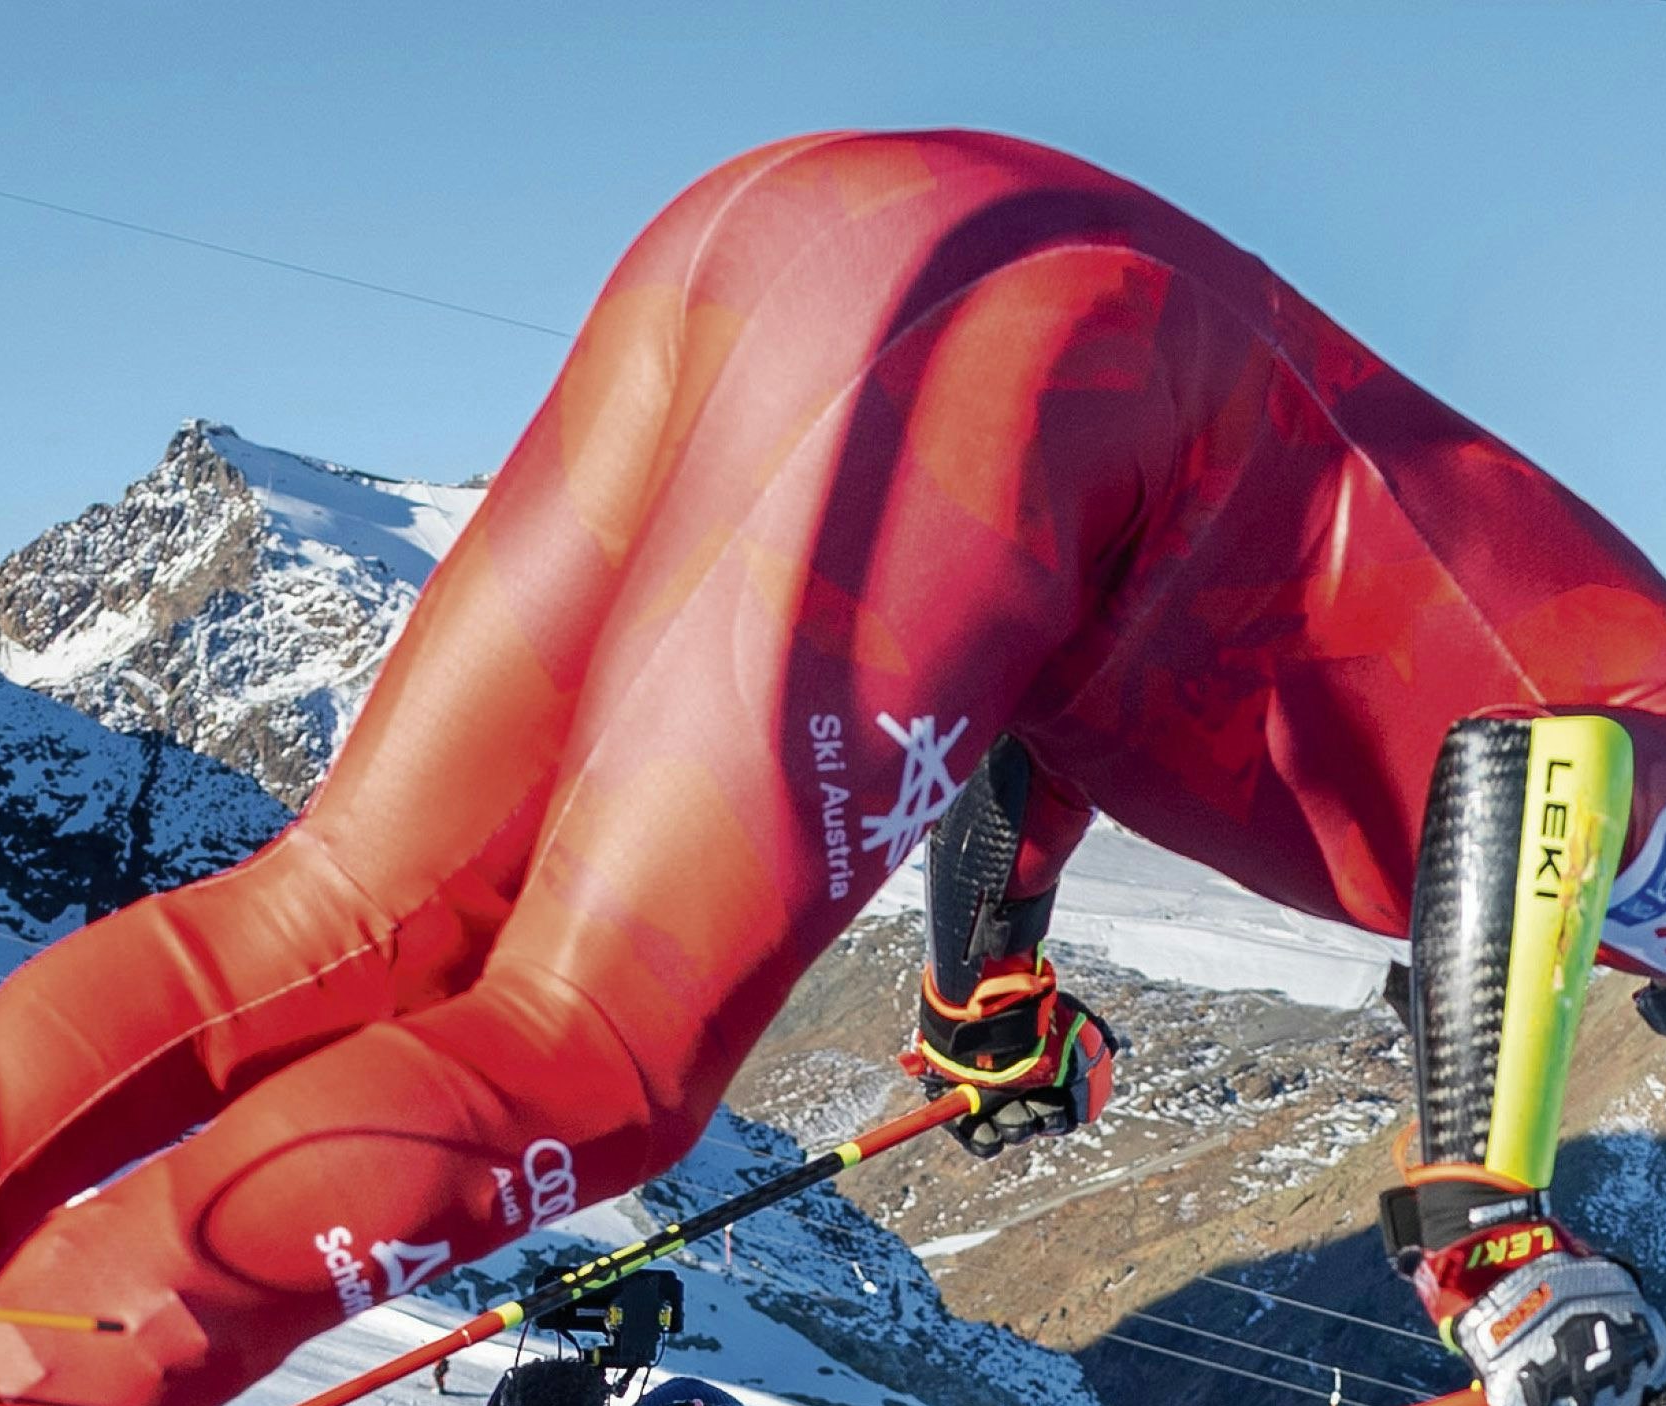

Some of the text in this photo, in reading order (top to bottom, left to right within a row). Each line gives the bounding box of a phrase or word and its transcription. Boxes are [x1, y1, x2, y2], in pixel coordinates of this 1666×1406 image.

[809, 714, 855, 901] Ski Austria
[1535, 759, 1573, 899] LEKI
[491, 1167, 523, 1226] Audi
[1467, 1225, 1554, 1270] LEKI
